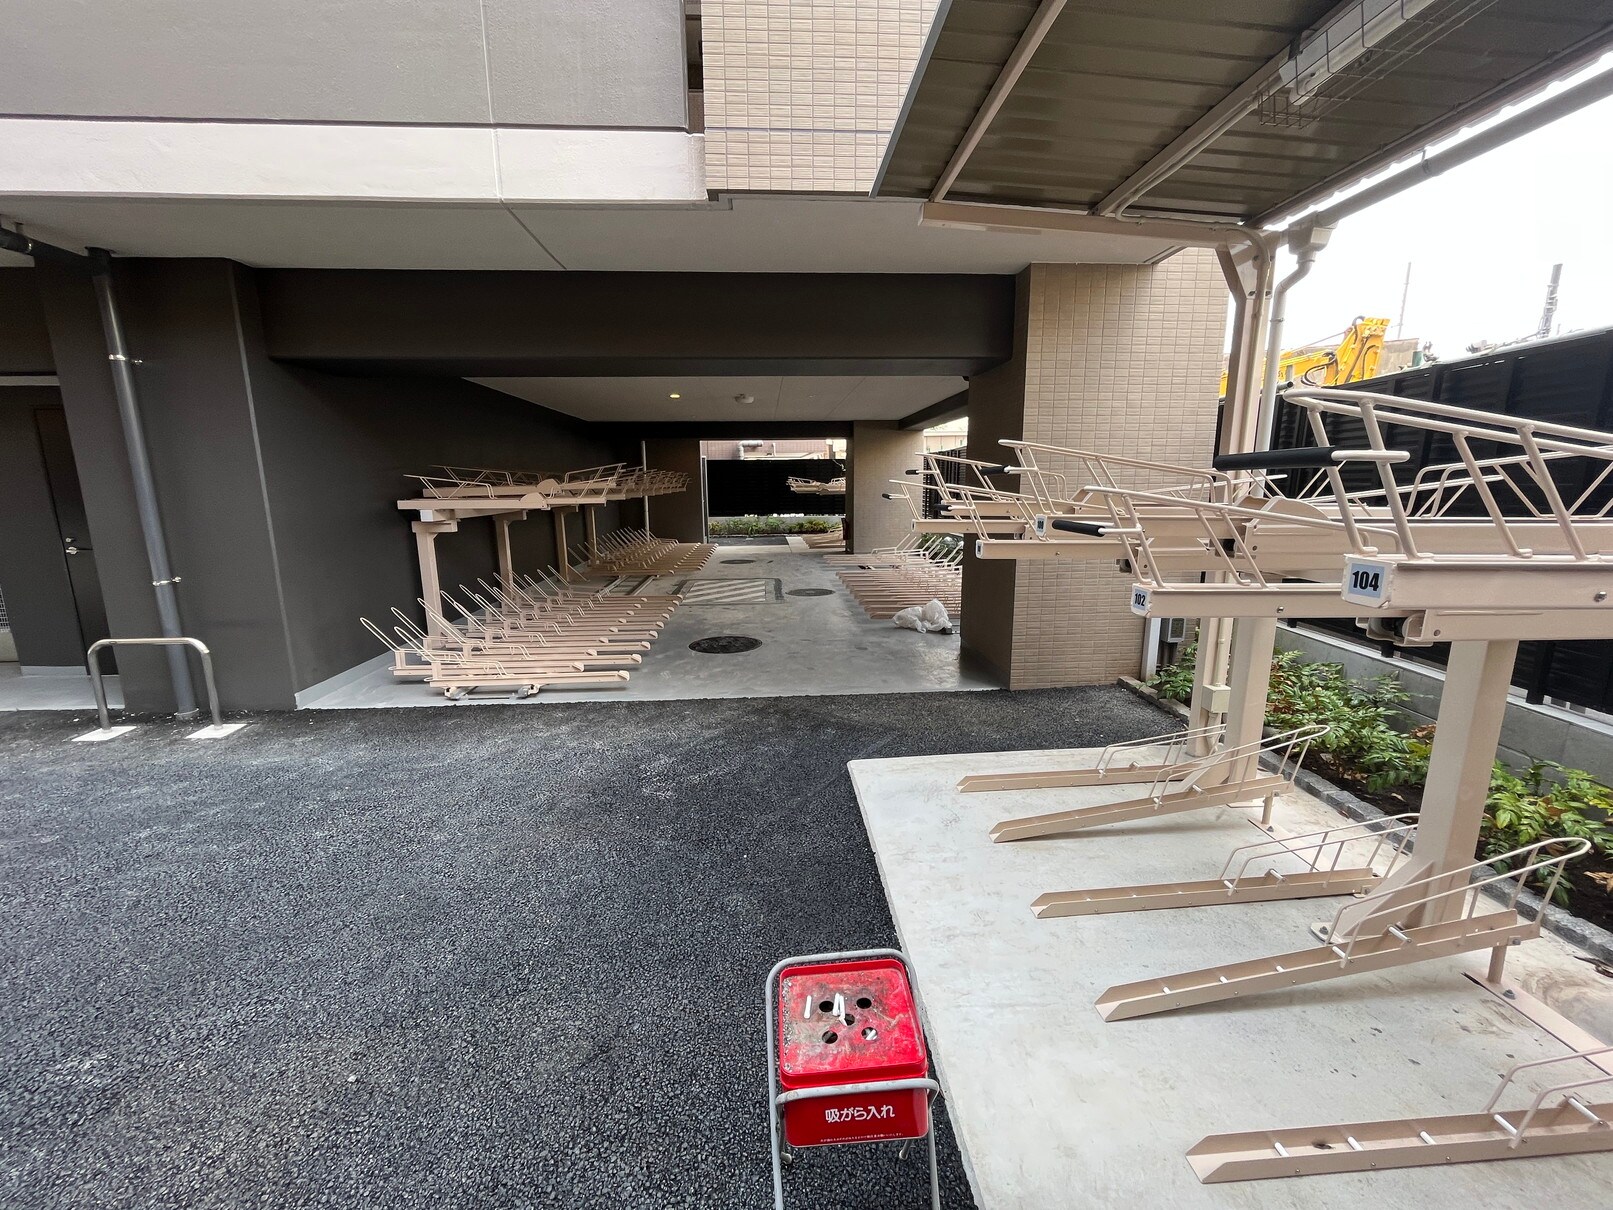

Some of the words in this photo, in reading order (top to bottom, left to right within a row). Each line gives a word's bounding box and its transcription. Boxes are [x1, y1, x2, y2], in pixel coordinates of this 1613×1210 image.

[1352, 570, 1380, 592] 104
[1134, 592, 1146, 607] 102
[825, 1104, 896, 1124] 吸がら入れ
